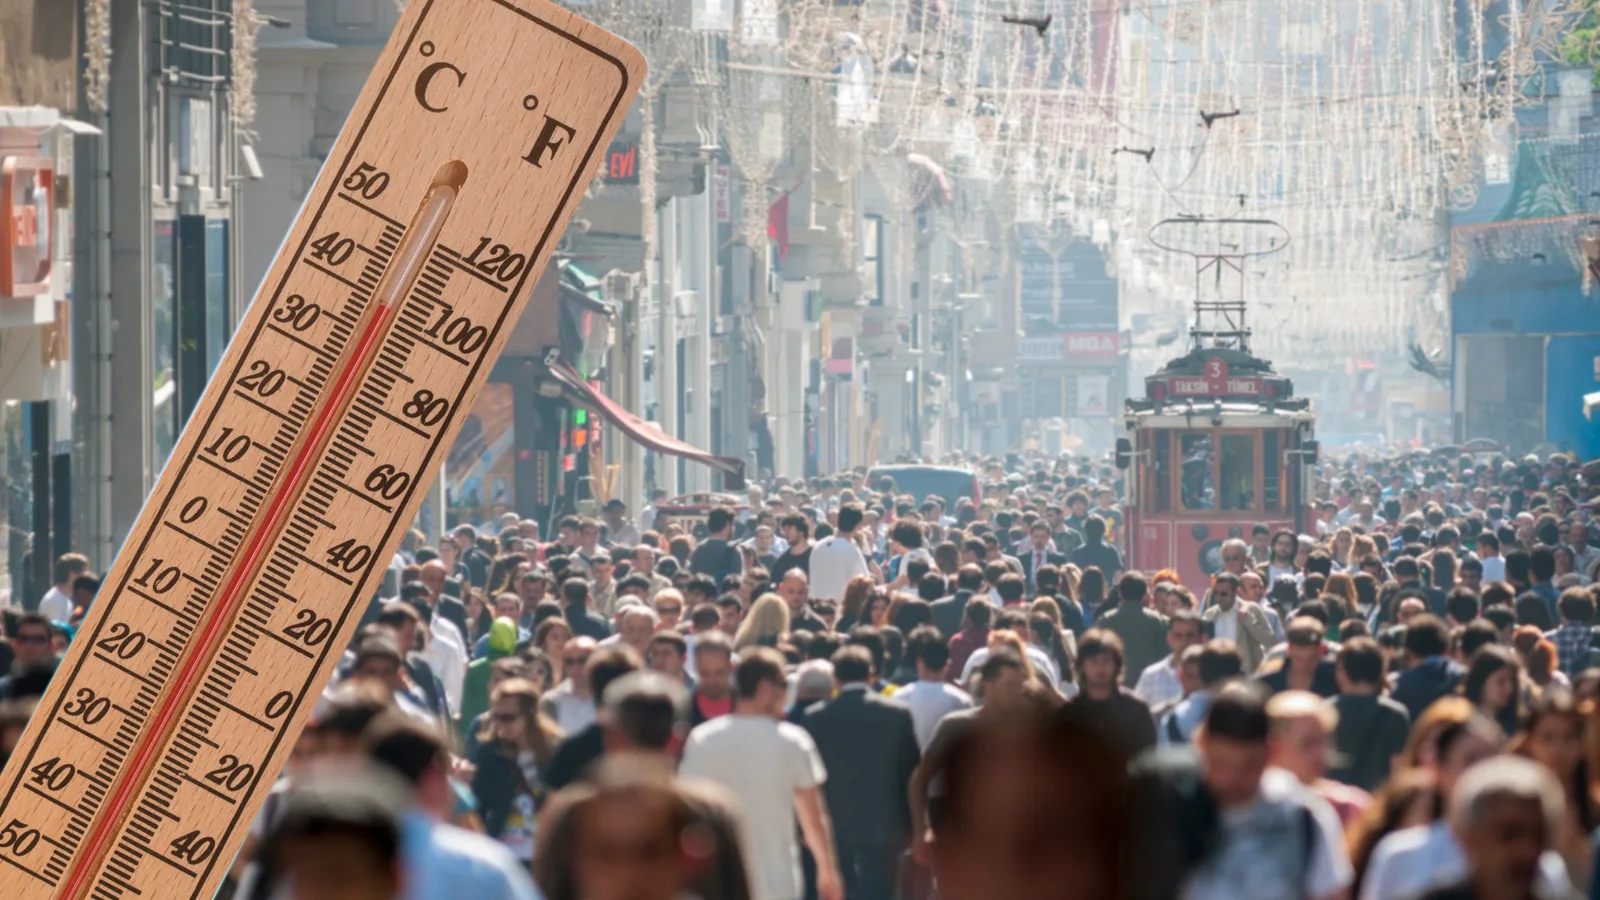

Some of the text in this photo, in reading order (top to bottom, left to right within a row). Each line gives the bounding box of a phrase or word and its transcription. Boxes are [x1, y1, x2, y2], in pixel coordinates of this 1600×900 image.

[343, 161, 390, 199] 50
[311, 231, 355, 266] 40
[461, 236, 527, 282] 120
[274, 294, 321, 332] 30
[423, 308, 488, 355] 100
[237, 359, 286, 397] 20
[1210, 361, 1221, 379] 3
[402, 389, 450, 427] 80
[203, 426, 250, 463] 10
[364, 463, 411, 501] 60
[180, 496, 208, 524] 0
[326, 538, 372, 574] 40
[134, 558, 183, 594] 10
[96, 622, 146, 660] 20
[281, 608, 333, 647] 20
[64, 687, 111, 725] 30
[265, 690, 294, 720] 0
[31, 756, 76, 792] 40
[205, 754, 255, 792] 20
[0, 818, 41, 857] 50
[170, 829, 216, 866] 40
